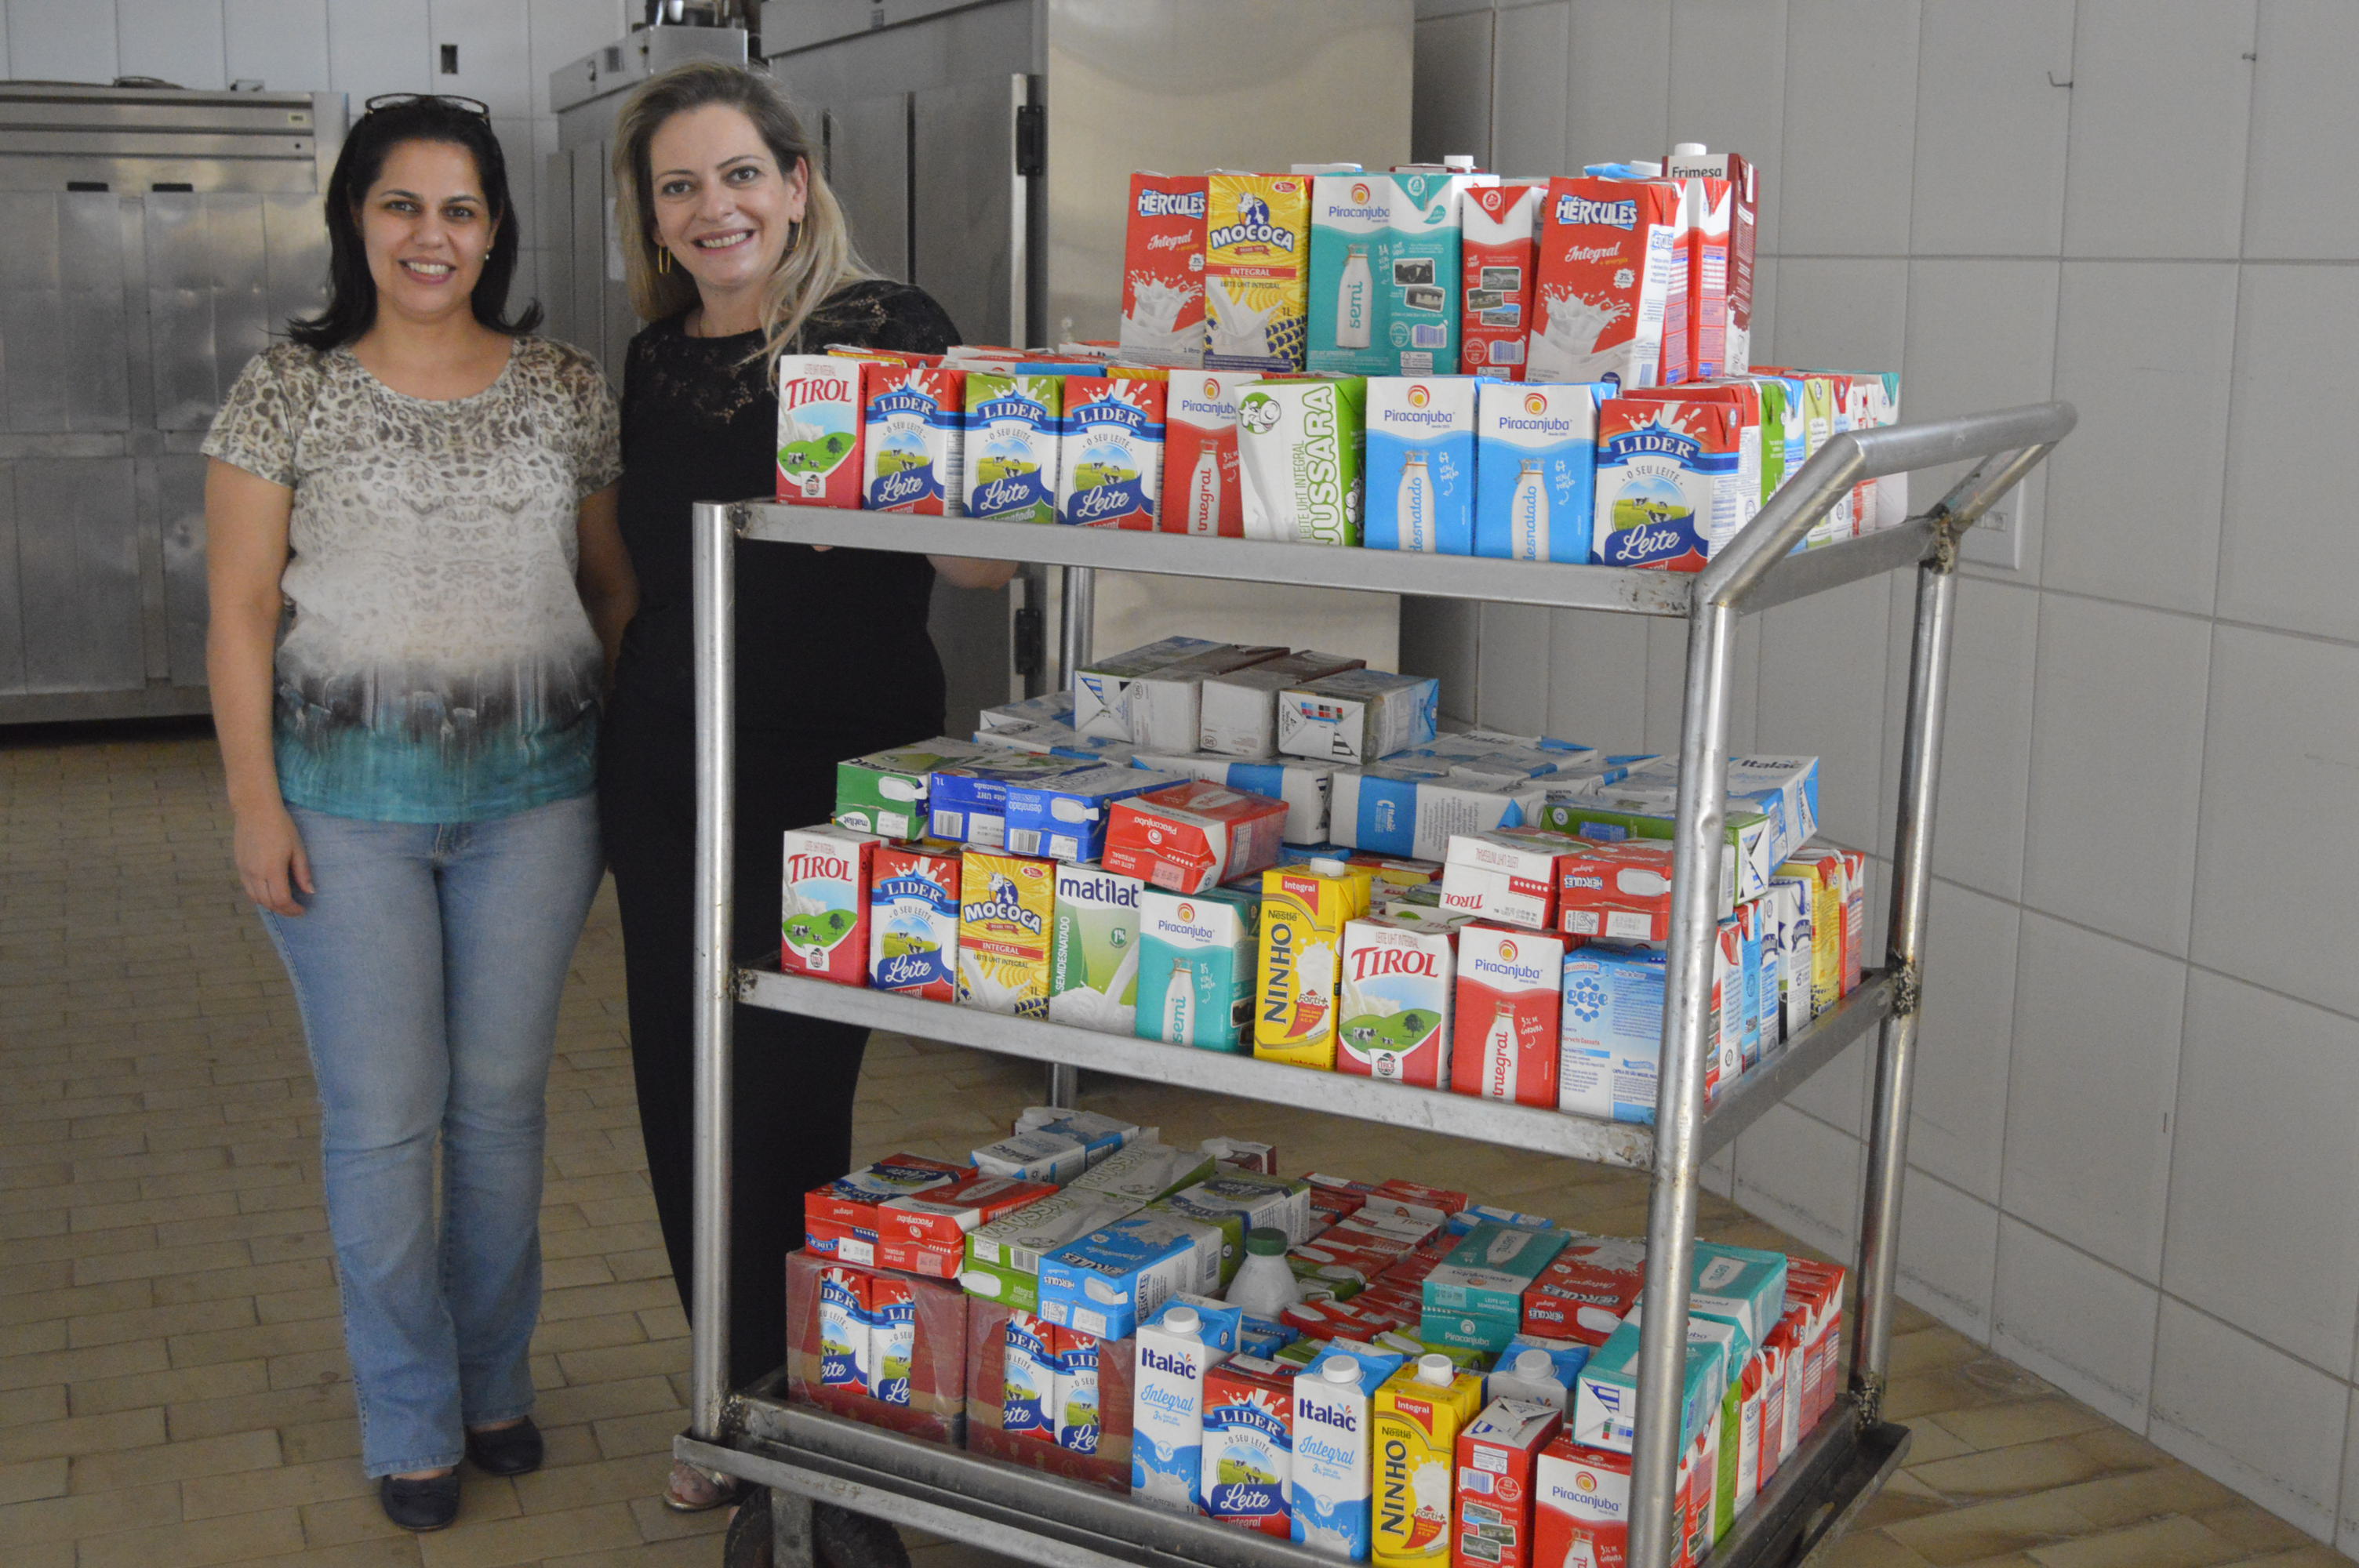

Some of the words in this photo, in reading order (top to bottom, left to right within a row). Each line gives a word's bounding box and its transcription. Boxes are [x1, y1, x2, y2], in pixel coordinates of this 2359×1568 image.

[1672, 166, 1722, 178] Frimesa
[1147, 229, 1193, 251] Integral
[1209, 223, 1294, 252] MOCOCA
[1564, 241, 1621, 263] Integral
[1230, 267, 1270, 277] INTEGRAL
[1347, 281, 1363, 329] semi
[784, 377, 853, 411] TIROL
[879, 395, 934, 416] LIDER
[983, 402, 1043, 423] LIDER
[1182, 399, 1237, 419] Piracanjub
[1079, 409, 1143, 428] LIDER
[1383, 408, 1453, 426] Piracanjuba
[1499, 416, 1570, 434] Piracanjuba
[893, 422, 906, 430] SEU
[907, 422, 925, 434] LEITE
[997, 428, 1011, 437] SEU
[1012, 428, 1031, 443] LEITE
[1094, 434, 1109, 442] SEU
[1110, 434, 1130, 448] LEITE
[1617, 437, 1695, 459] LIDER
[1292, 440, 1306, 488] INTEGRAL
[1301, 385, 1343, 546] JUSSARA
[1627, 470, 1633, 480] O
[1635, 466, 1652, 476] SEU
[1654, 466, 1681, 483] LEITE
[878, 470, 924, 502] Leite
[980, 478, 1030, 510] Leite
[1076, 485, 1130, 517] Leite
[1296, 489, 1307, 510] UHT
[1298, 511, 1311, 539] LEITE
[1616, 523, 1681, 561] Leite
[973, 782, 1007, 793] esnatado
[976, 791, 992, 800] UHT
[843, 816, 868, 827] matilat
[1133, 816, 1178, 836] Piracanjuba
[787, 853, 853, 884] TIROL
[887, 881, 942, 902] LIDER
[1059, 877, 1140, 909] matilat
[1284, 880, 1317, 893] Integral
[1445, 892, 1484, 909] TIROL
[900, 906, 913, 915] SEU
[914, 907, 932, 922] LEITE
[962, 900, 1042, 936] MOCOCA
[1113, 928, 1126, 942] 1%
[1158, 919, 1213, 940] Piracanjuba
[982, 942, 1020, 955] INTEGRAL
[1056, 916, 1071, 994] SEMIDESNATADO
[884, 954, 932, 983] Leite
[973, 954, 988, 963] LEITE
[988, 956, 1001, 964] UHT
[1001, 958, 1029, 969] INTEGRAL
[1350, 946, 1439, 982] TIROL
[1474, 958, 1540, 979] Piracanjuba
[1263, 923, 1293, 1026] NINHO
[1030, 986, 1041, 996] 1L
[1297, 993, 1329, 1007] Forti+
[1171, 995, 1187, 1044] semi
[1376, 1060, 1396, 1069] TIROL
[1492, 1030, 1512, 1097] integral
[896, 1214, 934, 1229] Piracanjuba
[809, 1237, 834, 1250] LIDER
[821, 1287, 857, 1308] DER
[829, 1311, 847, 1326] LEITE
[1006, 1330, 1041, 1353] DER
[1444, 1331, 1490, 1347] Piracanjuba
[821, 1361, 847, 1377] eite
[1013, 1355, 1031, 1371] LEITE
[1067, 1352, 1098, 1367] LID
[1141, 1347, 1198, 1381] Italac
[1081, 1377, 1095, 1386] SEU
[1140, 1383, 1194, 1413] Integral
[1397, 1400, 1430, 1414] Integral
[1004, 1406, 1031, 1424] eite
[1220, 1409, 1281, 1437] LIDER
[1299, 1398, 1358, 1433] Italac
[1069, 1423, 1099, 1451] Lei
[1234, 1434, 1249, 1443] SEU
[1250, 1436, 1270, 1453] LEITE
[1299, 1436, 1355, 1465] Integral
[1219, 1482, 1270, 1512] Leite
[1380, 1439, 1407, 1537] NINHO
[1551, 1485, 1619, 1512] Piracanjuba
[1415, 1507, 1446, 1522] Forti+
